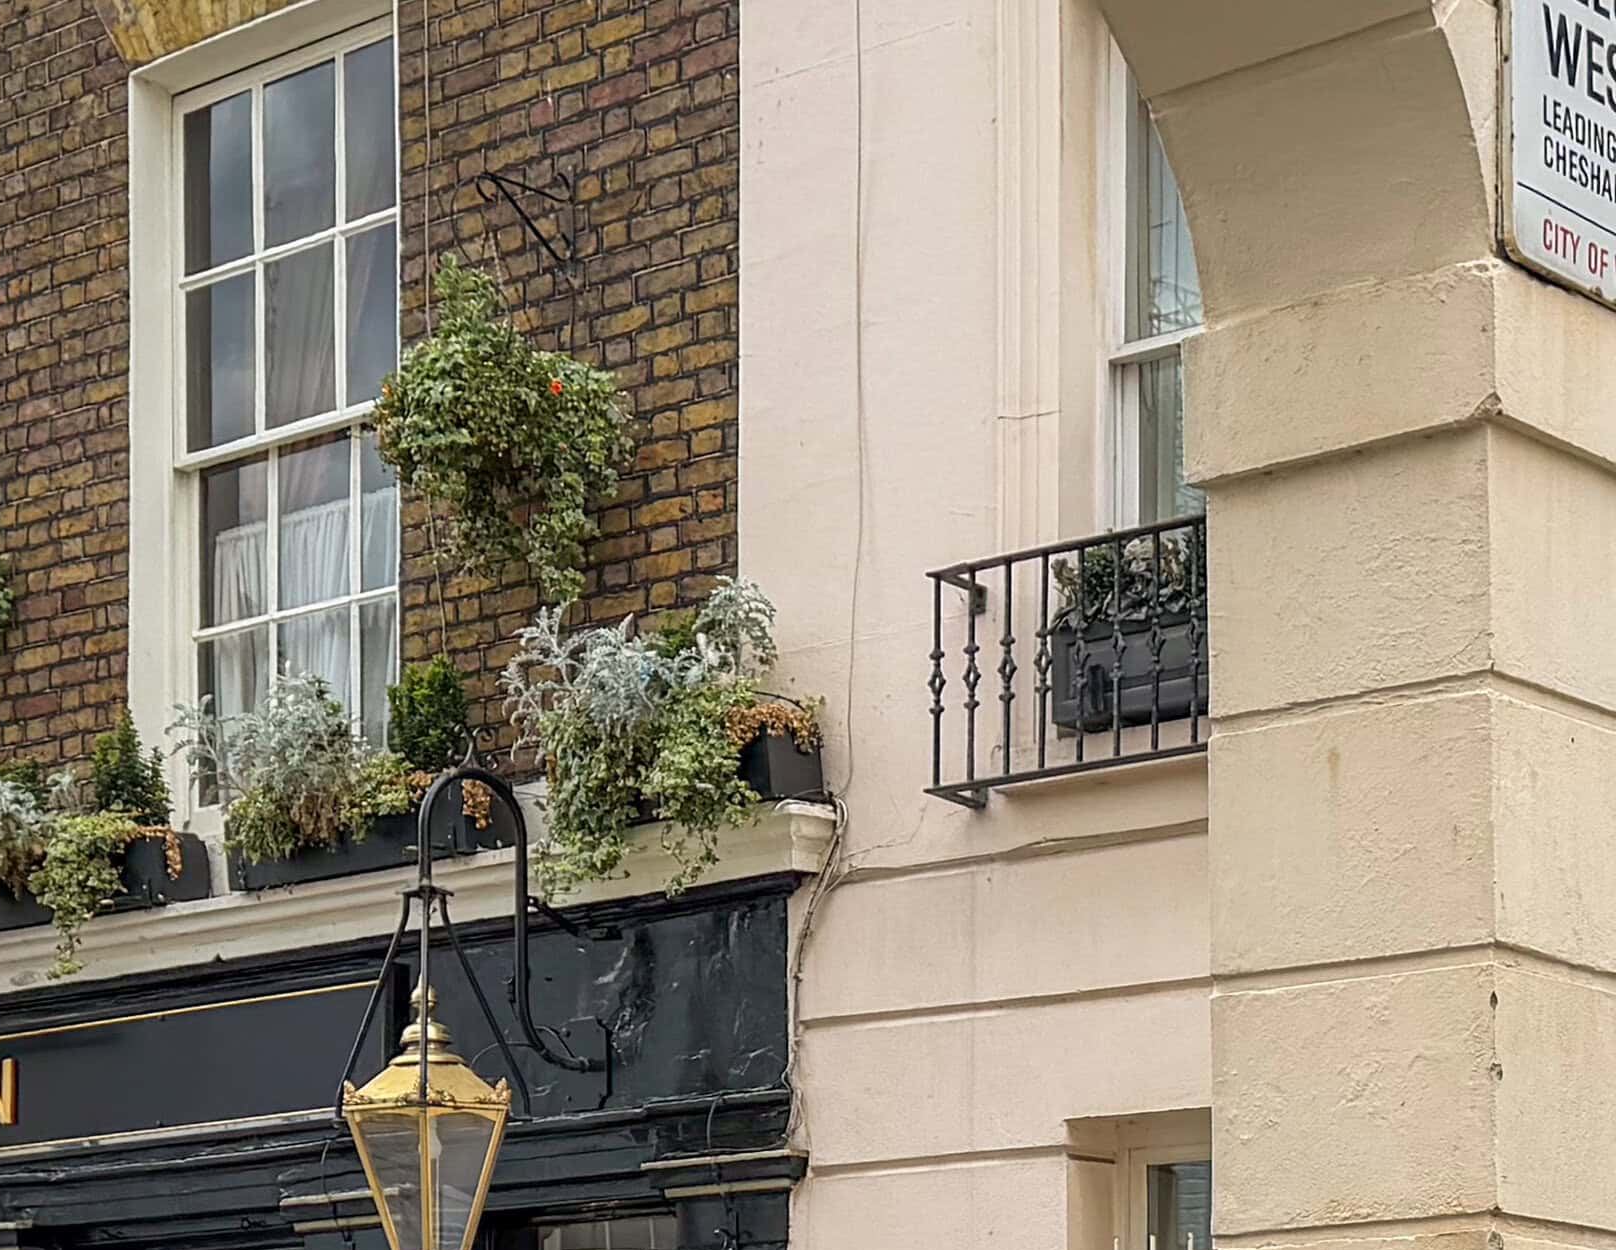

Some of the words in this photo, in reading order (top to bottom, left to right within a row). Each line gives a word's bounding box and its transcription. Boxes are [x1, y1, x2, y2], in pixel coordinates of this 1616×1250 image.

[1543, 136, 1616, 203] CHESHA
[1543, 218, 1581, 265] CITY
[1588, 242, 1609, 279] OF
